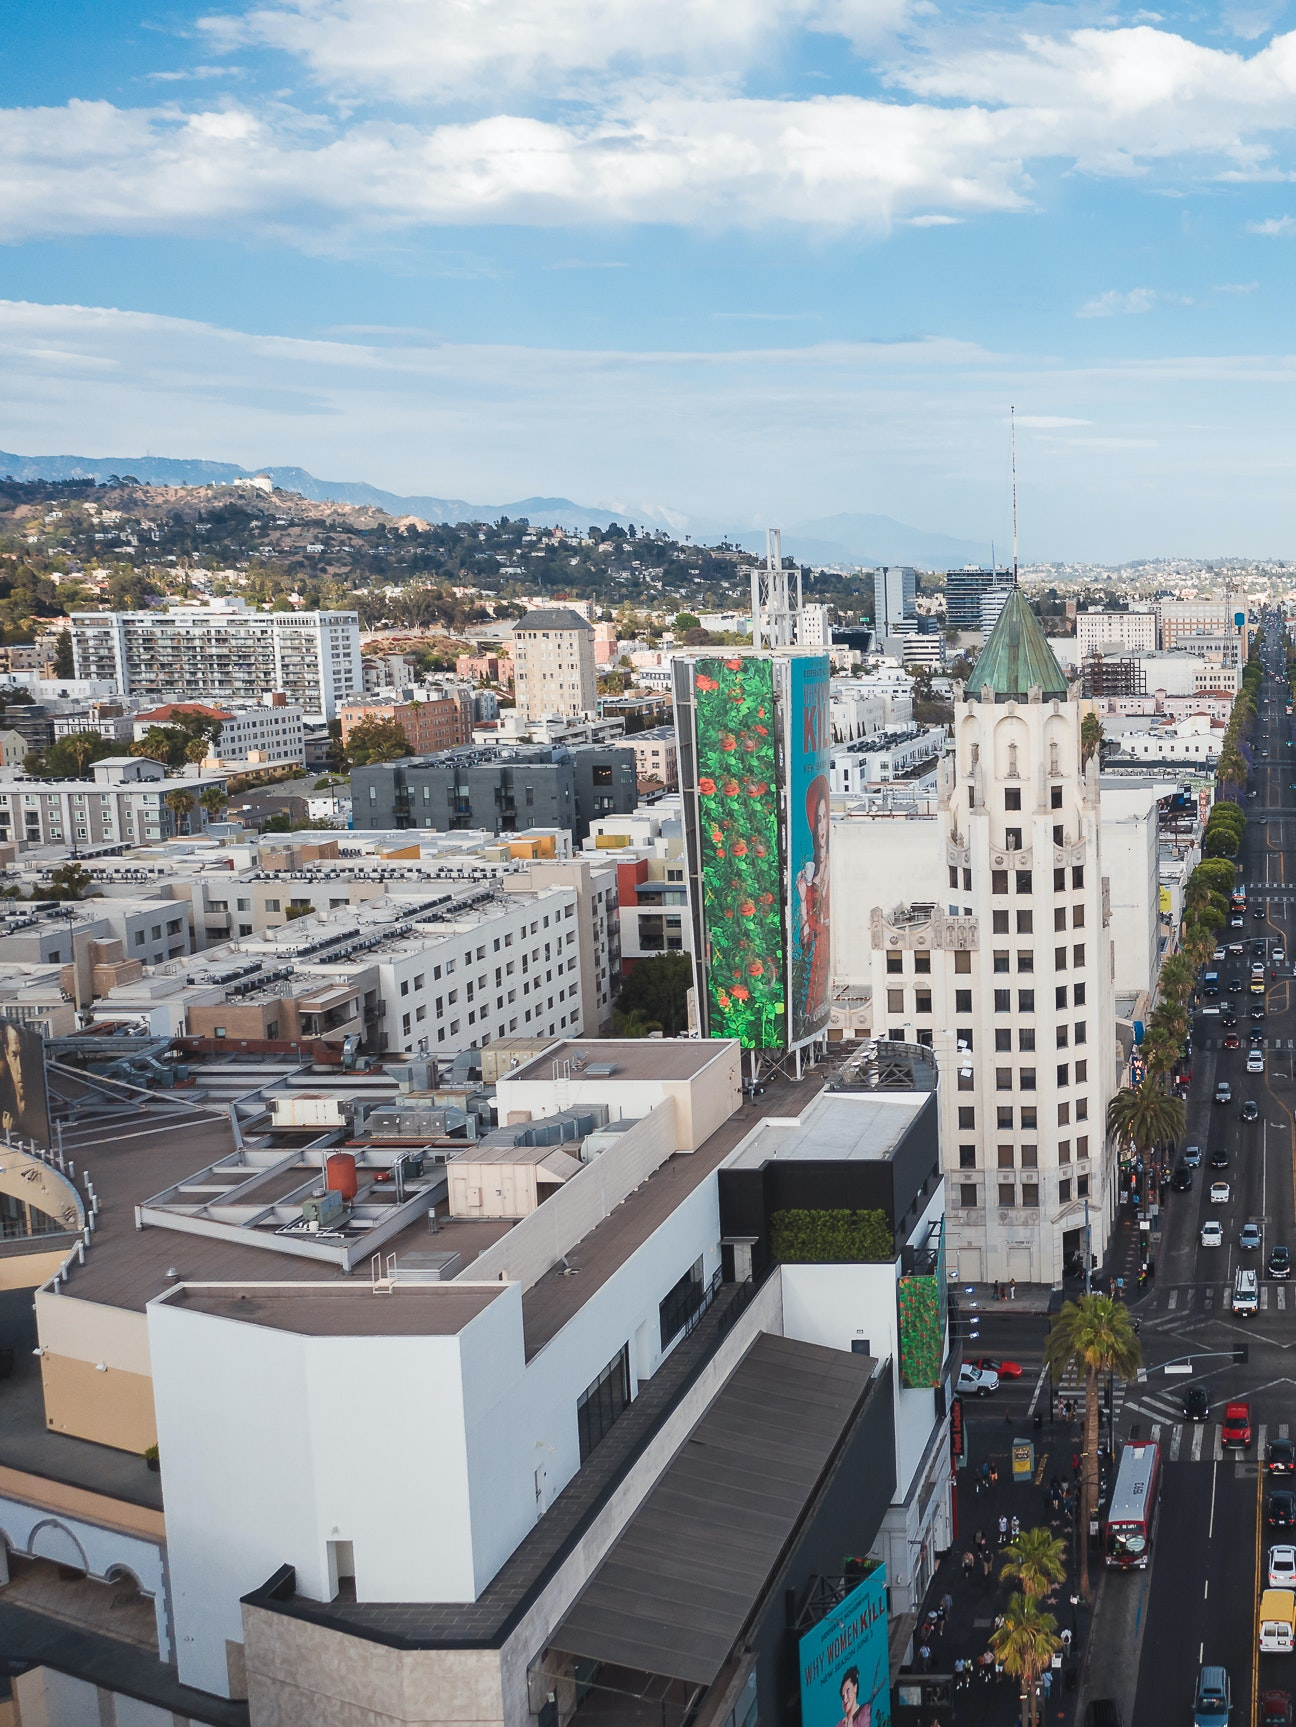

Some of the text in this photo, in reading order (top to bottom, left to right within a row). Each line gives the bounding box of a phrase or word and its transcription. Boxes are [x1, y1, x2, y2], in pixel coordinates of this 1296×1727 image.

[1133, 1060, 1142, 1081] WAX
[804, 1651, 825, 1687] WHY
[826, 1618, 859, 1665] WOMEN
[860, 1596, 885, 1634] KILL
[834, 1649, 856, 1673] SEASON
